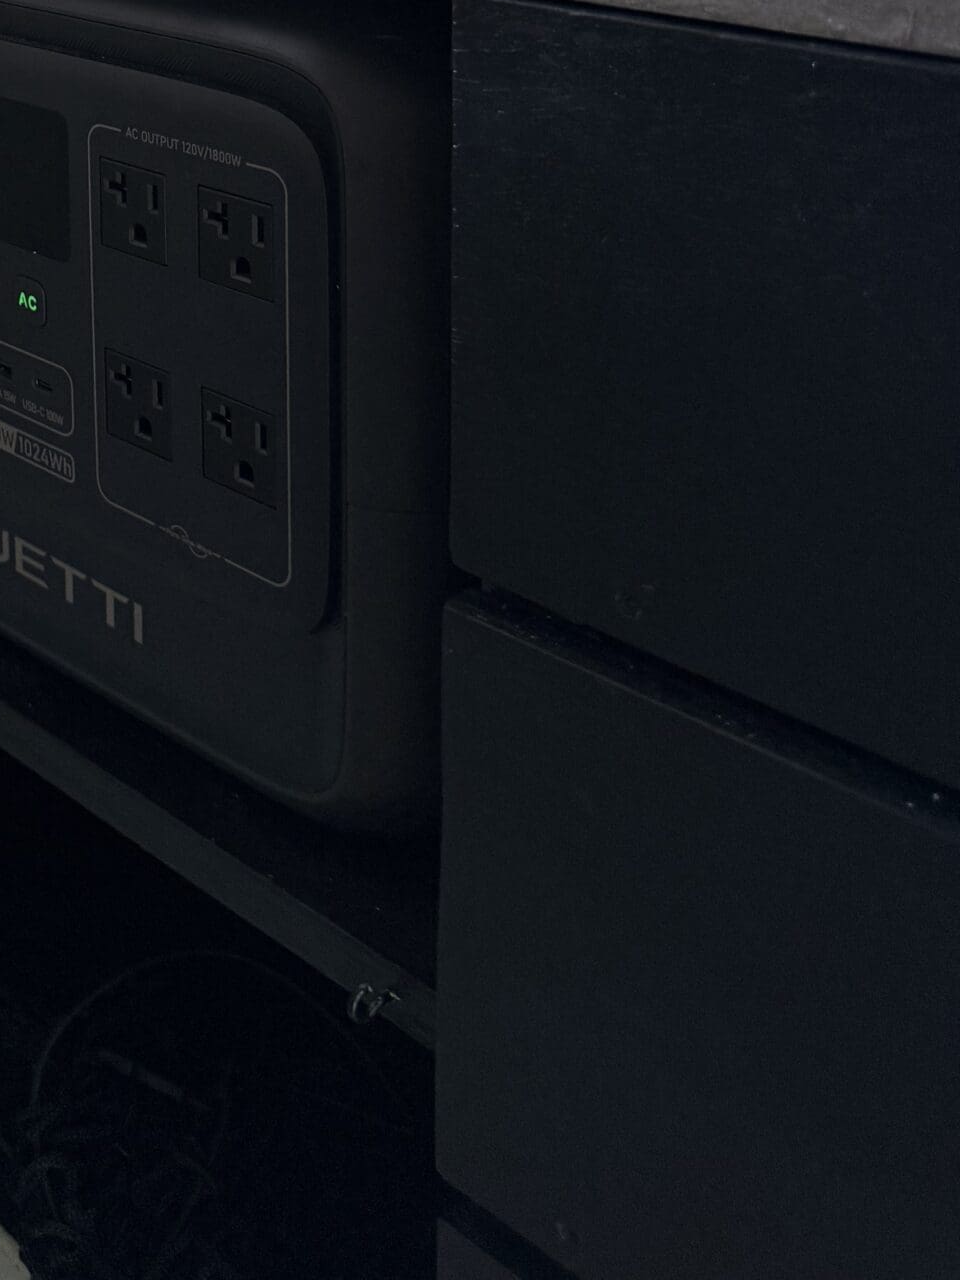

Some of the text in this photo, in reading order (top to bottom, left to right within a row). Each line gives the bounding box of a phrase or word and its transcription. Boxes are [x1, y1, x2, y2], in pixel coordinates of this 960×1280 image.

[125, 126, 242, 167] AC OUTPUT 120V/1800W
[18, 291, 39, 312] AC
[18, 435, 73, 478] 1024Wh
